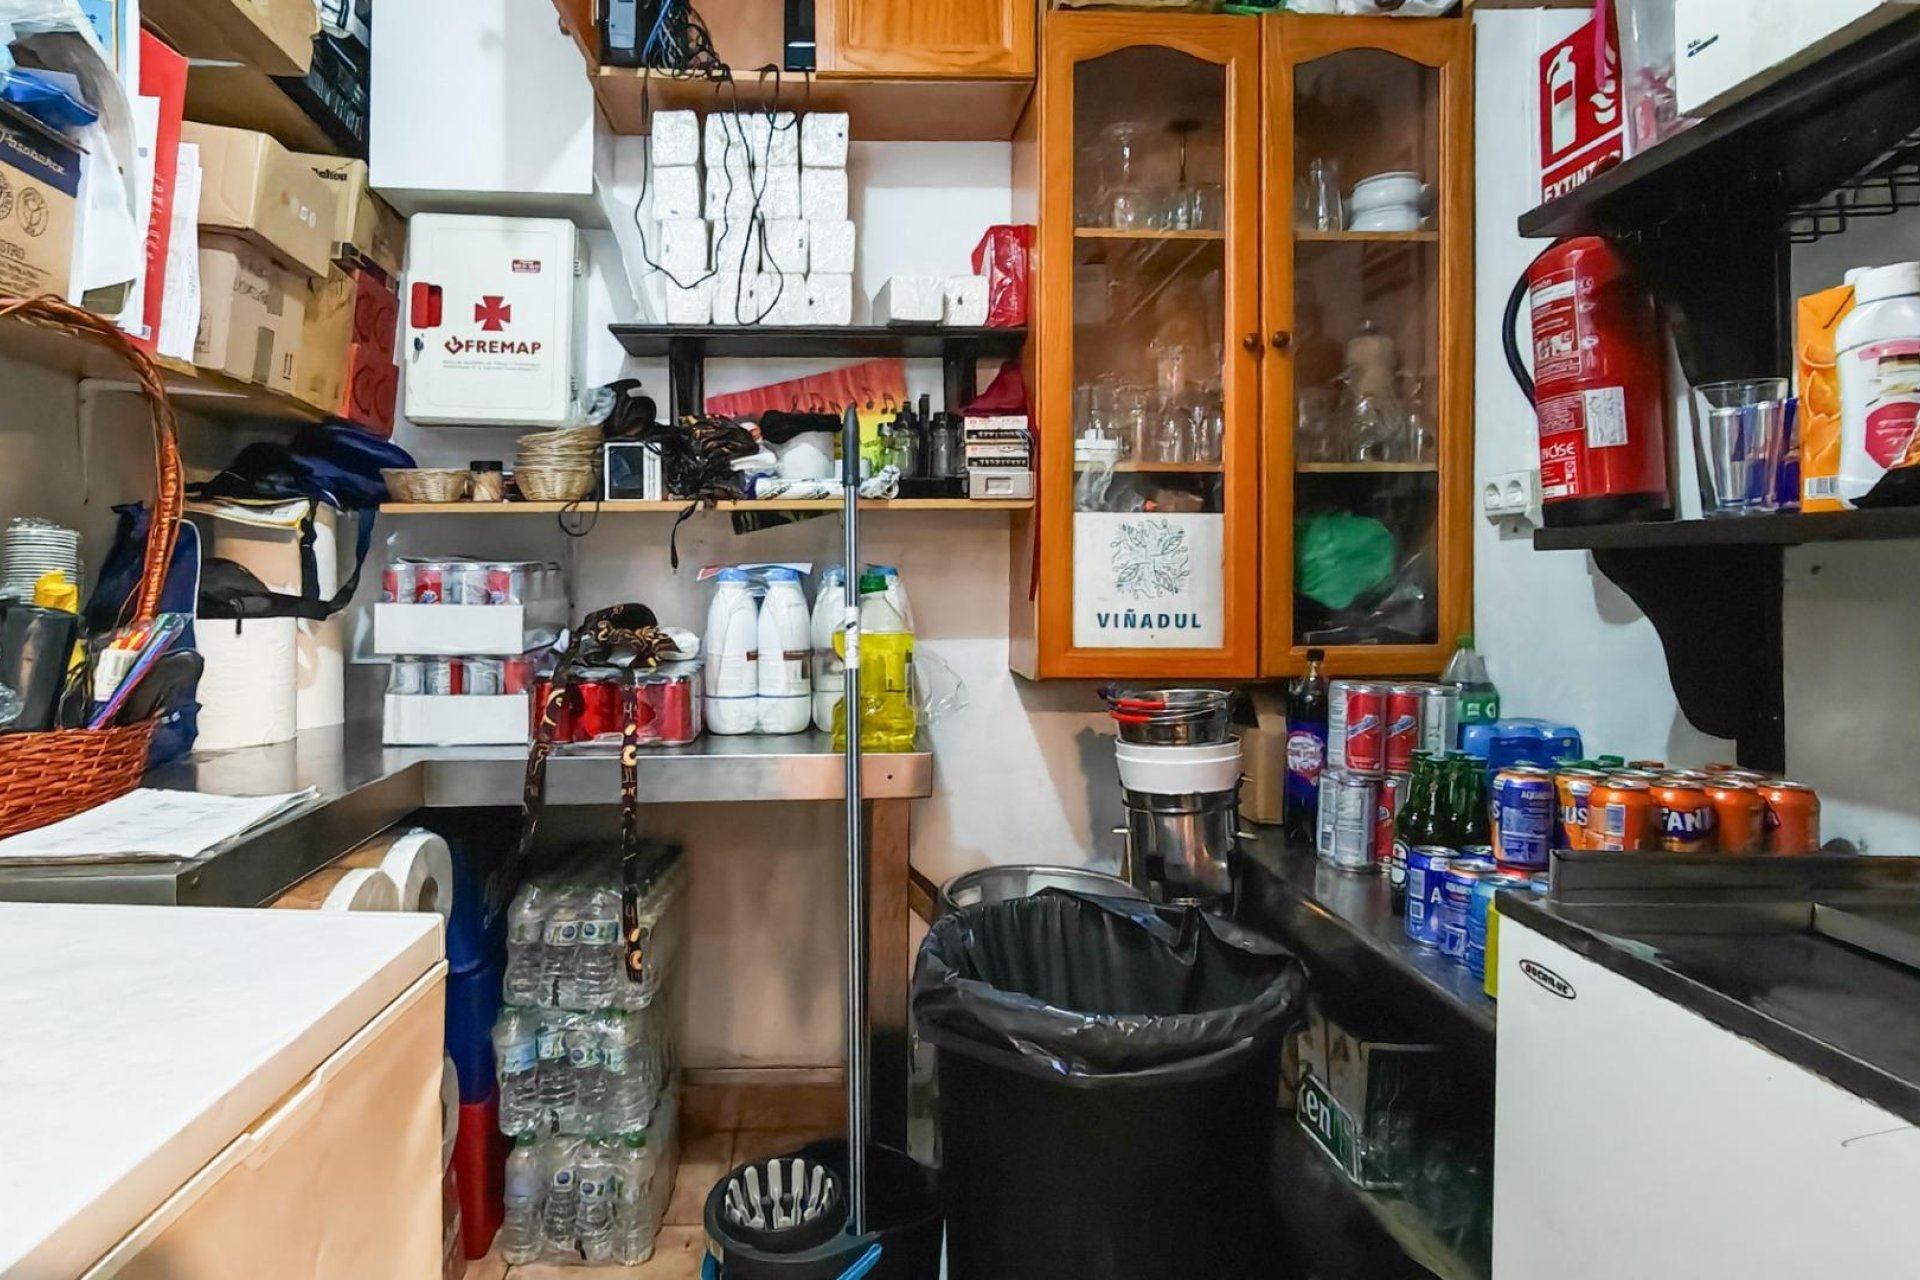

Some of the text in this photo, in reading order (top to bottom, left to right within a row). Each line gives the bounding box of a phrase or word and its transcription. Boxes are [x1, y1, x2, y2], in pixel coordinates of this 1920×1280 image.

[1543, 149, 1621, 204] EXTINT
[465, 339, 542, 355] FREMAP
[1096, 608, 1202, 629] VIÑADUL
